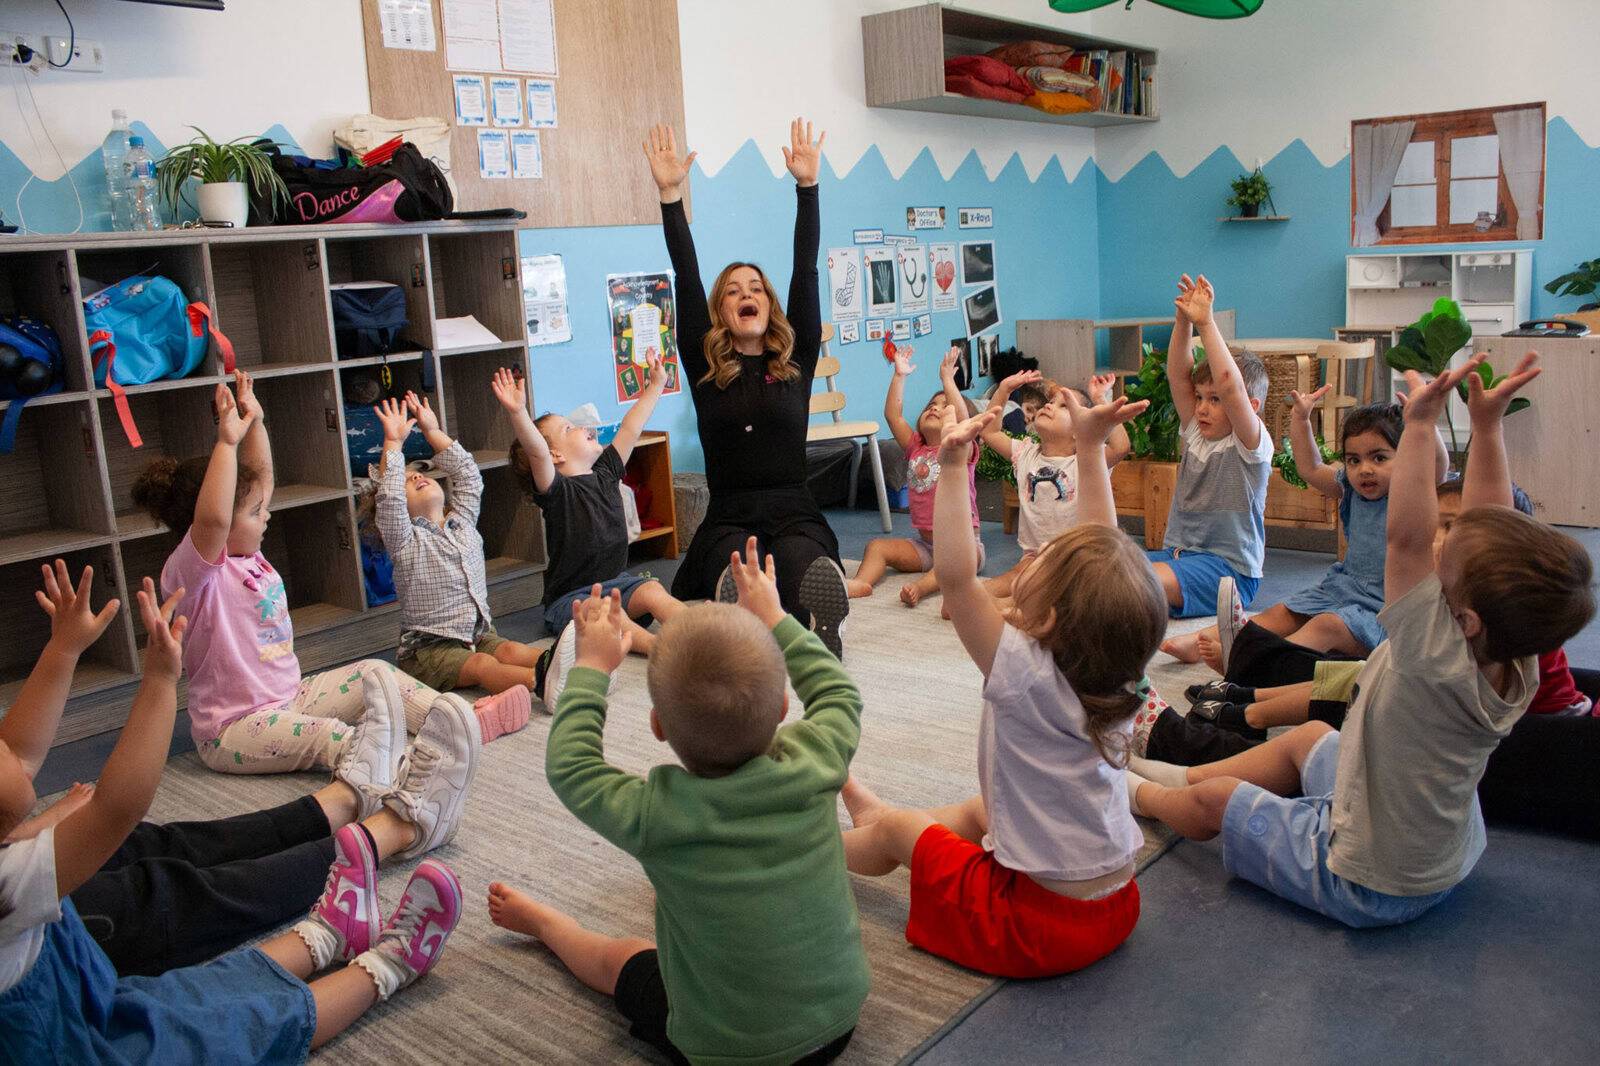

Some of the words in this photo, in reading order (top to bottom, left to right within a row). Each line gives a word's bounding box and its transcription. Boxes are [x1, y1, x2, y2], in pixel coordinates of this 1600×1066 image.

[293, 186, 360, 222] Dance
[920, 219, 937, 227] Office
[969, 213, 991, 224] X-Rays
